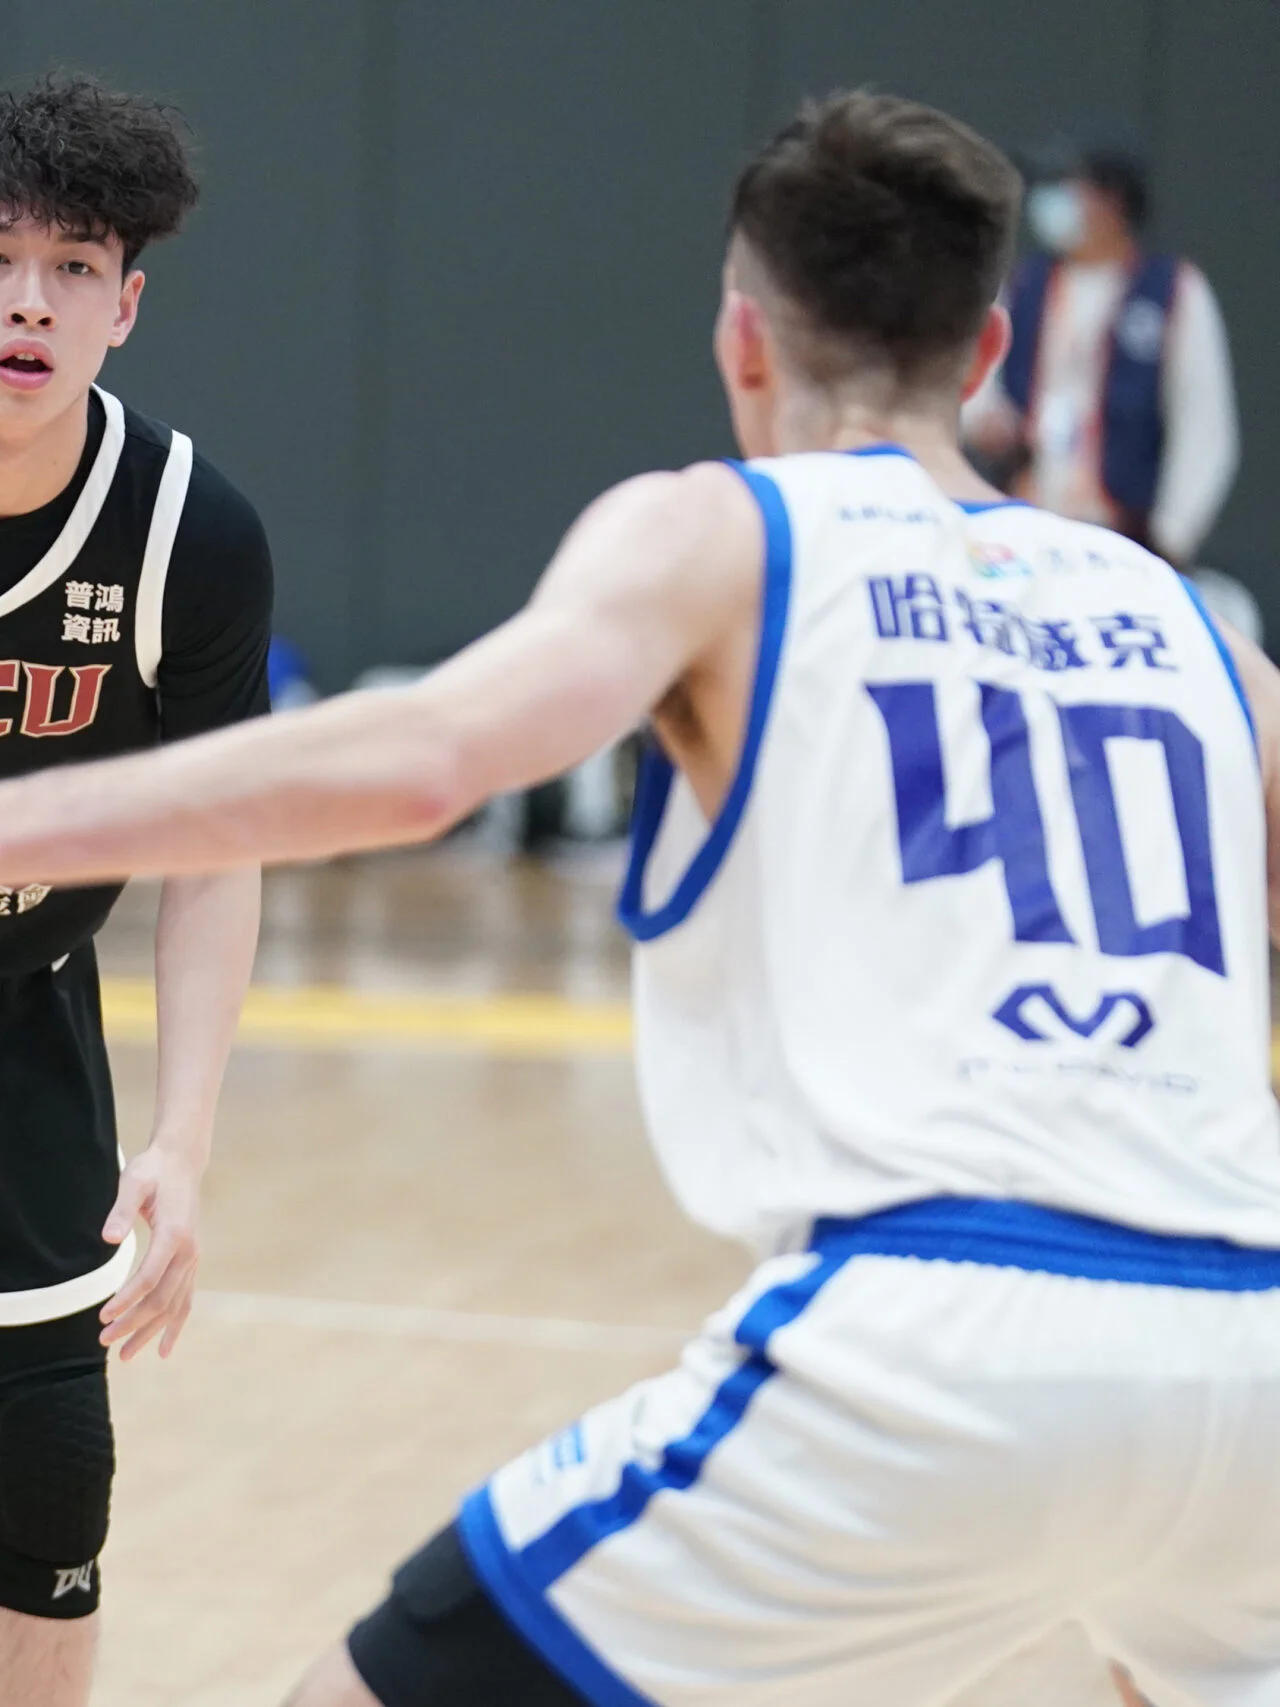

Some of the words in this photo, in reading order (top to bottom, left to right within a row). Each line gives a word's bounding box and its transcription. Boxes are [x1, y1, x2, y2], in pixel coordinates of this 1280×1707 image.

[64, 580, 124, 613] 普鴻
[61, 612, 121, 644] 資訊
[863, 678, 1228, 978] 40
